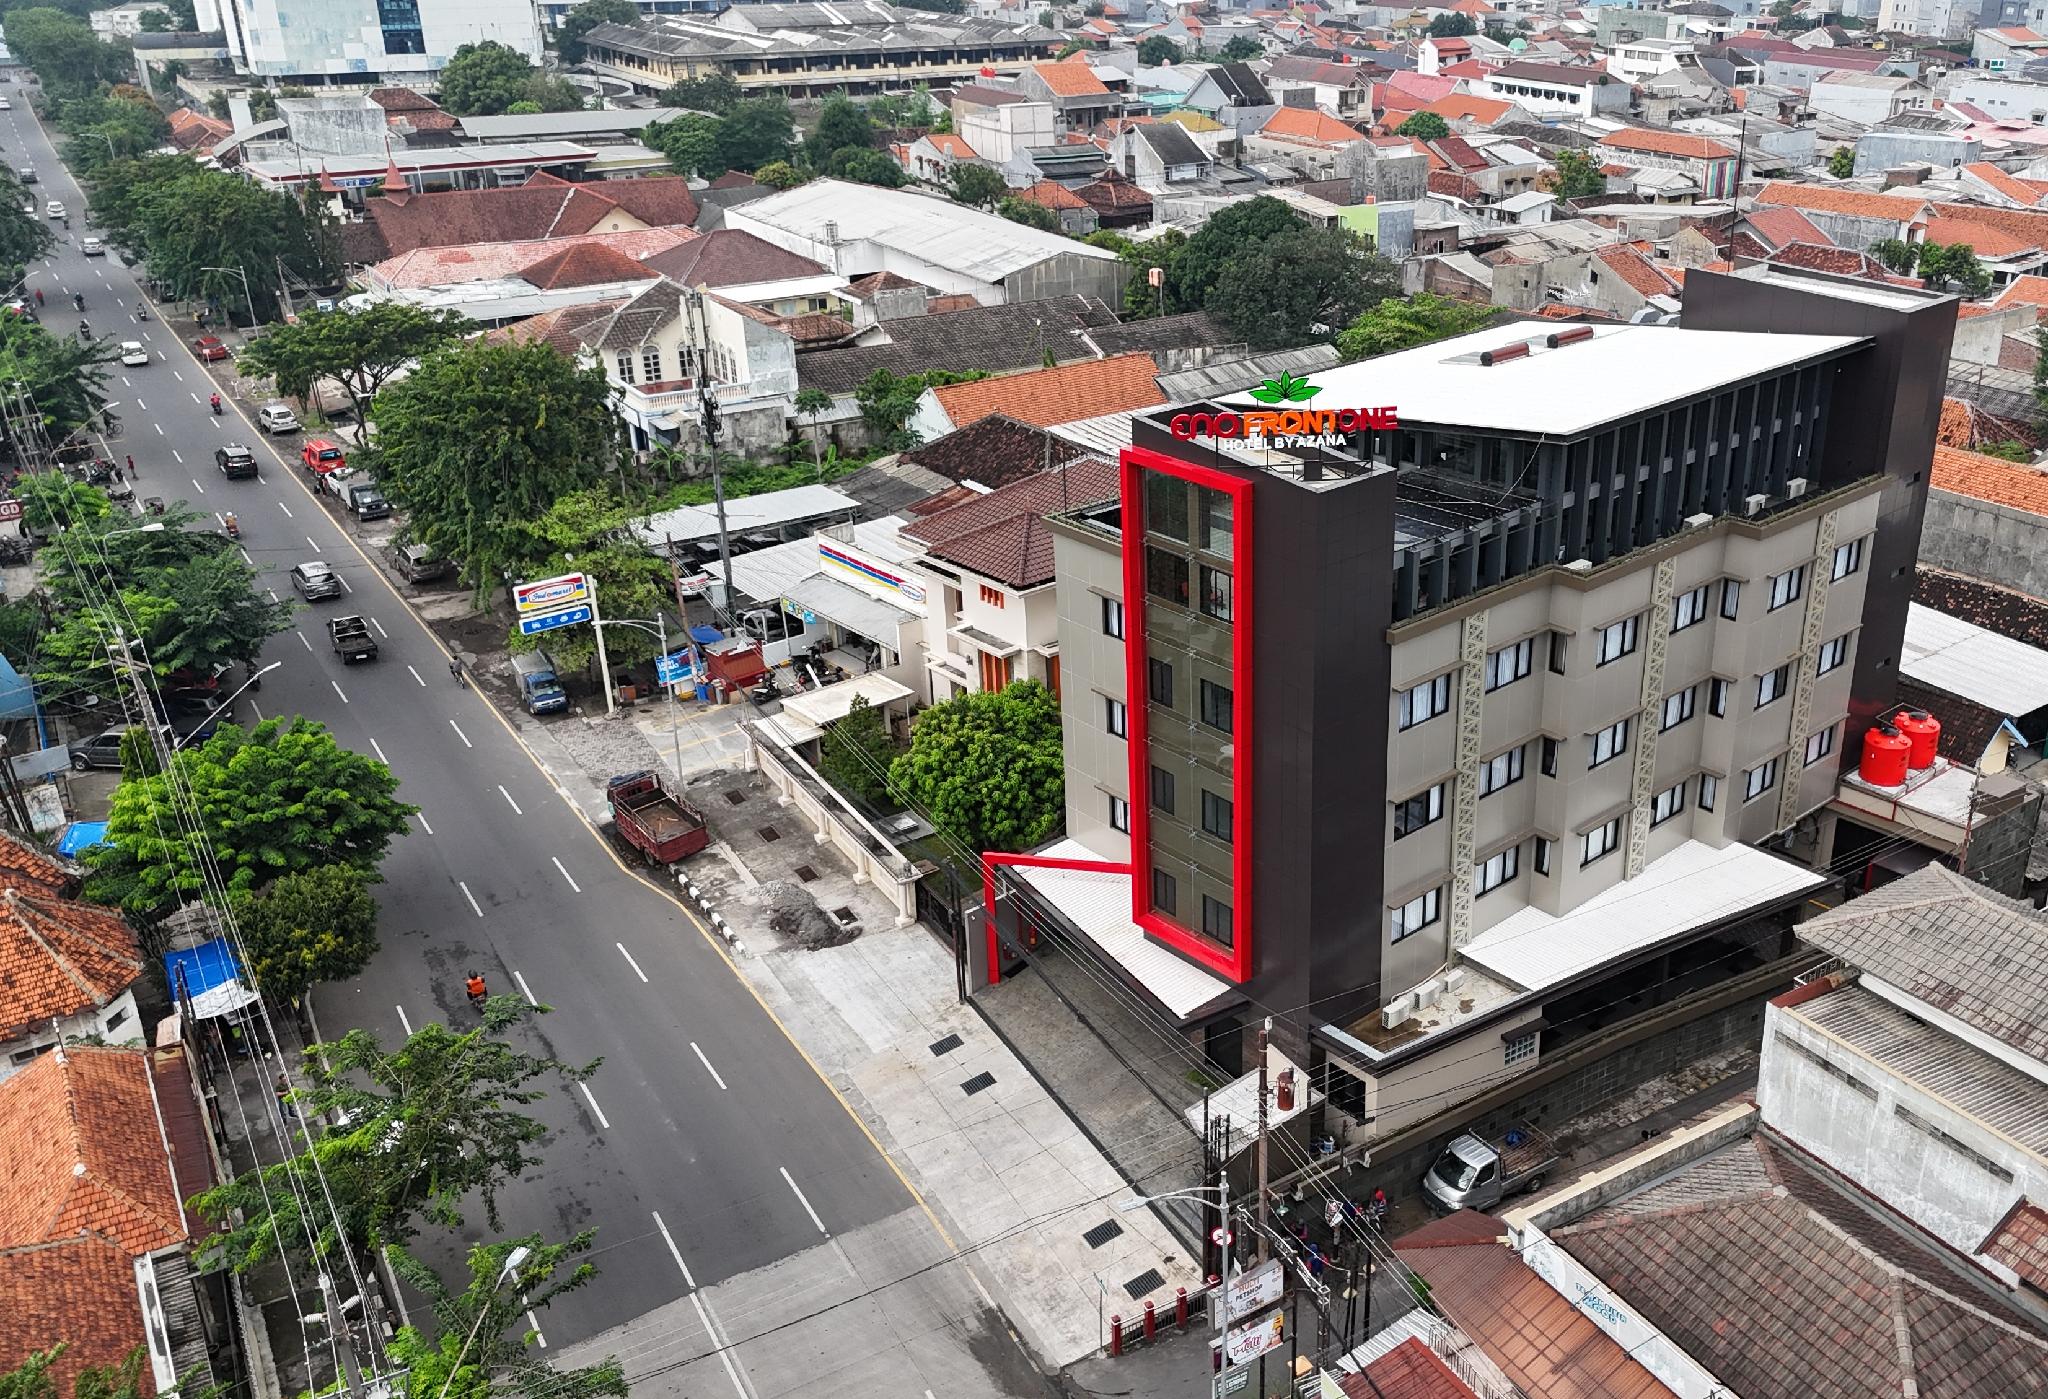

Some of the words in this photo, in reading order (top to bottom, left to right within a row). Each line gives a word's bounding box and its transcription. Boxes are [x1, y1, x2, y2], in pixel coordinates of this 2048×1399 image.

[1224, 436, 1273, 450] HOTEL
[1275, 437, 1293, 449] BY
[1295, 434, 1346, 448] AZANA
